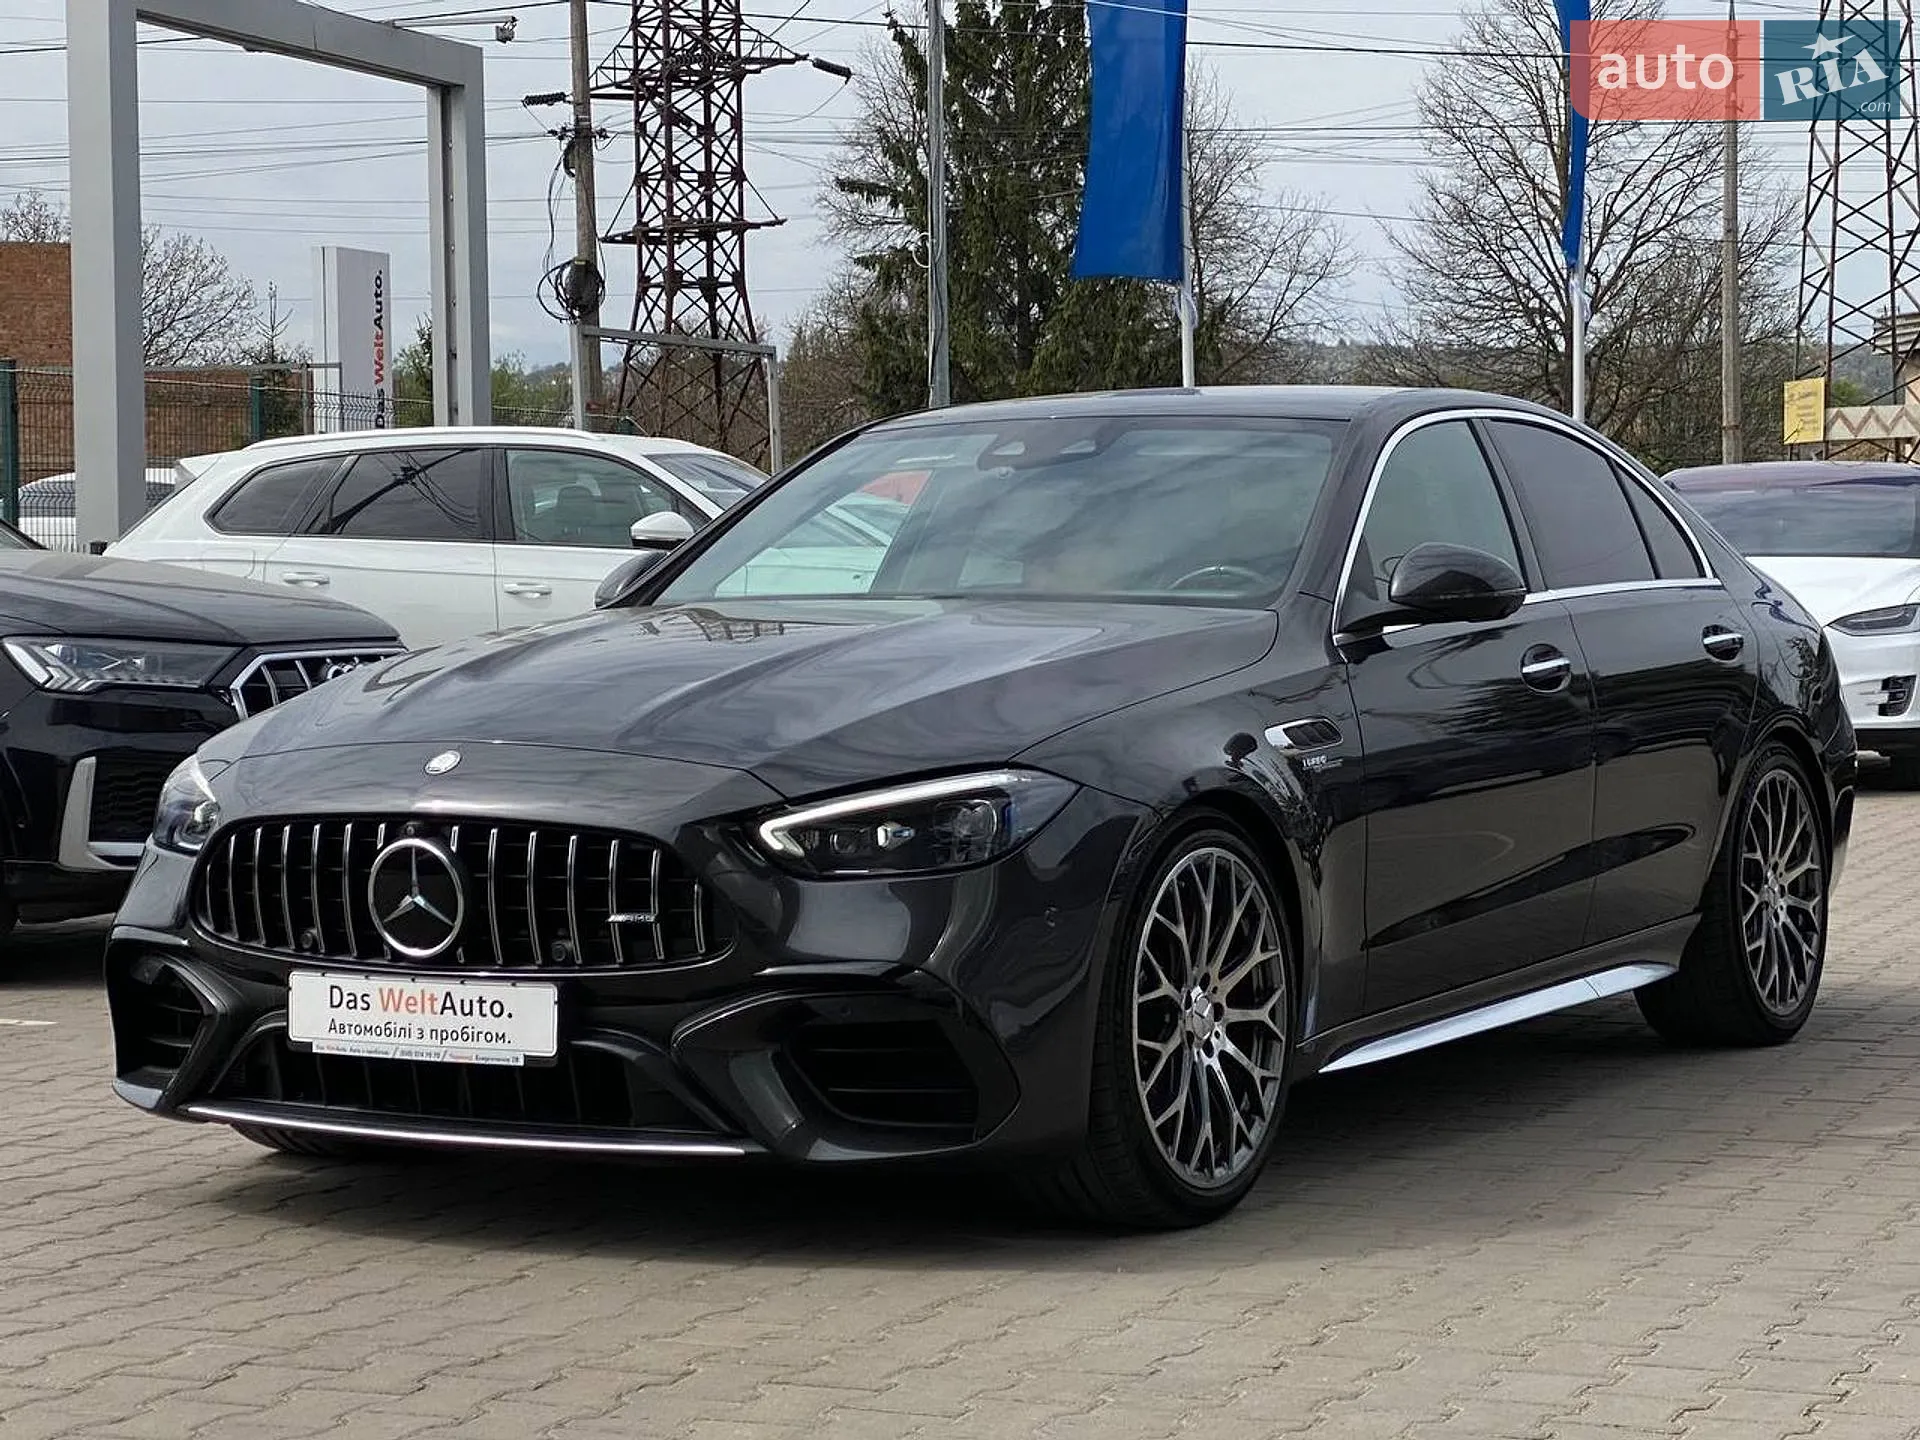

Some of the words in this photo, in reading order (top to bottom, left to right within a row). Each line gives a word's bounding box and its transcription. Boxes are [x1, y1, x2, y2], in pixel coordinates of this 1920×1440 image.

[374, 269, 384, 385] WeltAuto.
[375, 387, 385, 430] Das
[329, 985, 371, 1011] Das
[378, 987, 513, 1019] WeltAuto.
[328, 1017, 412, 1040] Автомобілі
[416, 1026, 425, 1040] з
[429, 1024, 512, 1045] пробігом.
